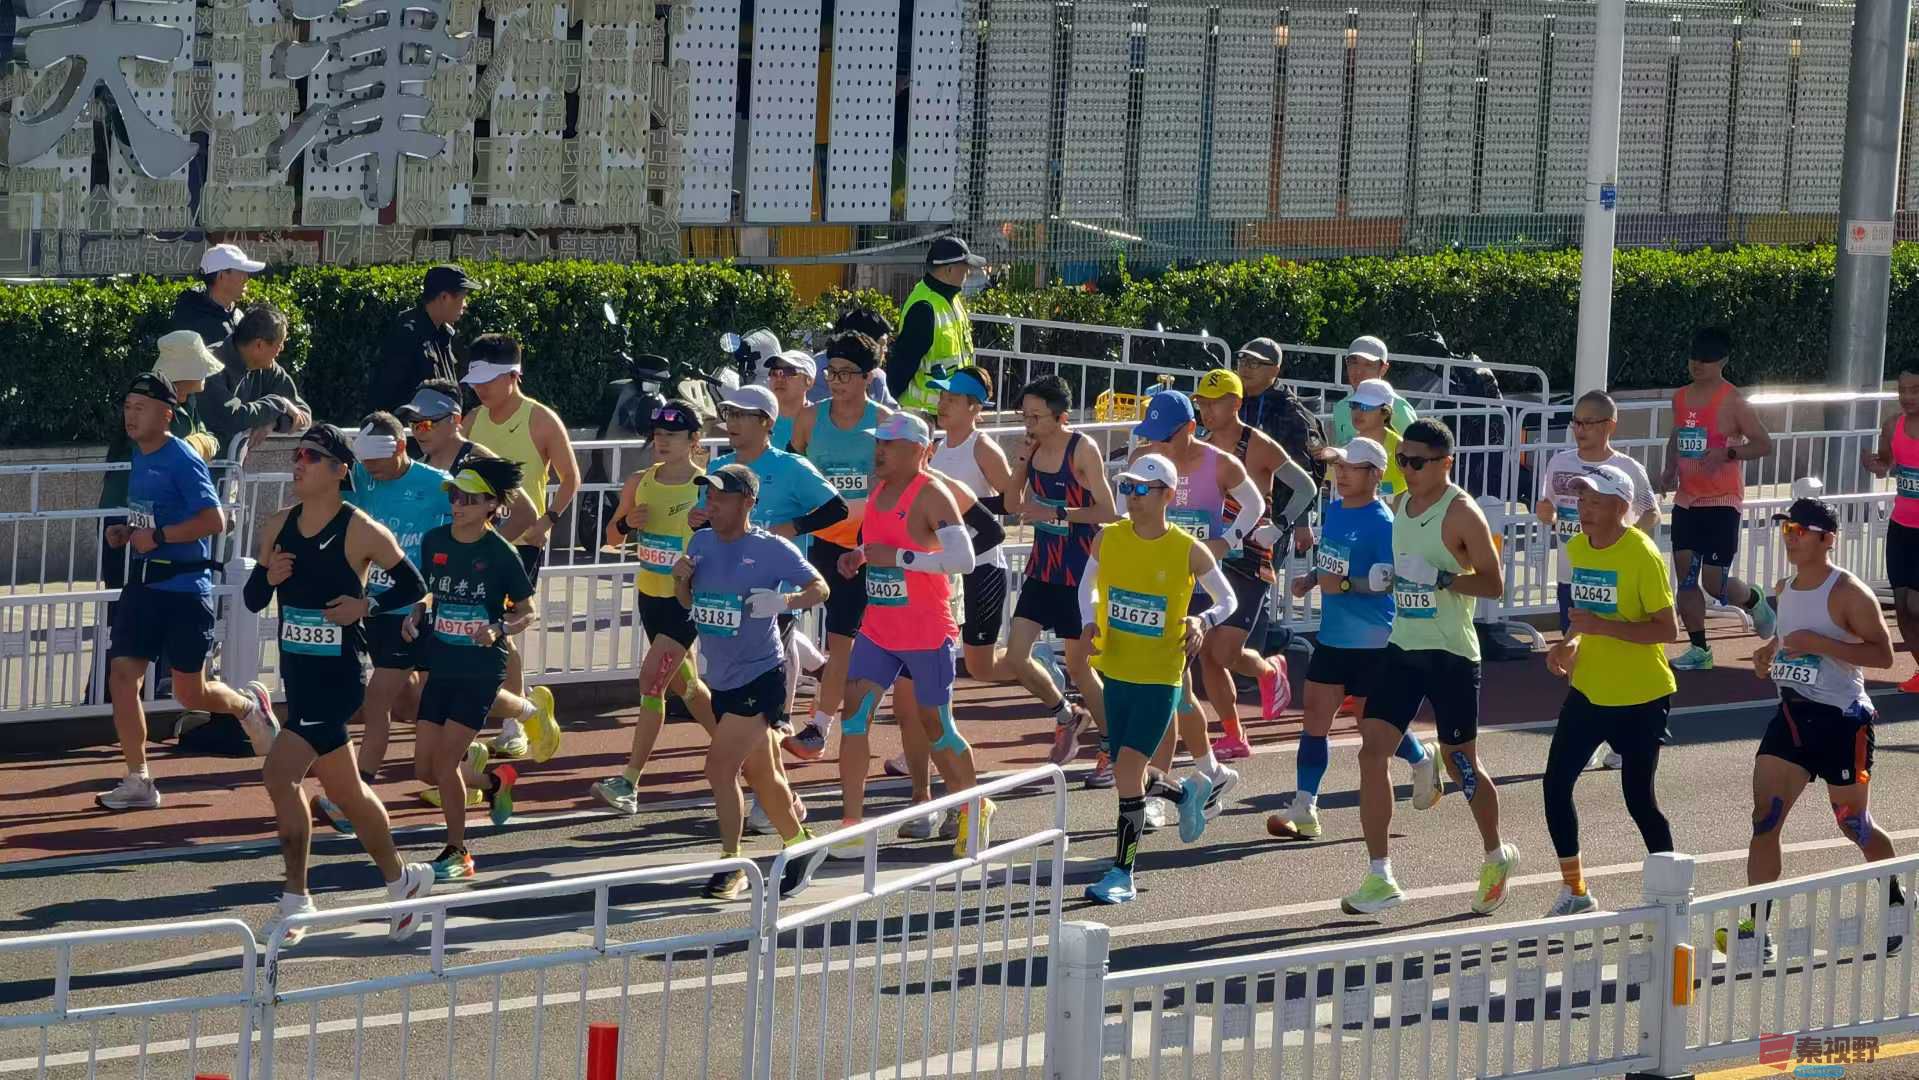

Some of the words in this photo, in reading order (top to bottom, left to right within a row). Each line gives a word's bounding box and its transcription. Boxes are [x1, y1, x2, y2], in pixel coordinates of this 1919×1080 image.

[8, 0, 472, 210] 天津
[1560, 522, 1581, 534] A44
[429, 573, 486, 599] 中国老兵
[1574, 587, 1611, 602] A2642
[694, 608, 734, 626] A3181
[1111, 604, 1159, 626] B1673
[285, 625, 335, 643] A3383
[437, 619, 483, 635] A9767
[1772, 665, 1810, 682] A4763
